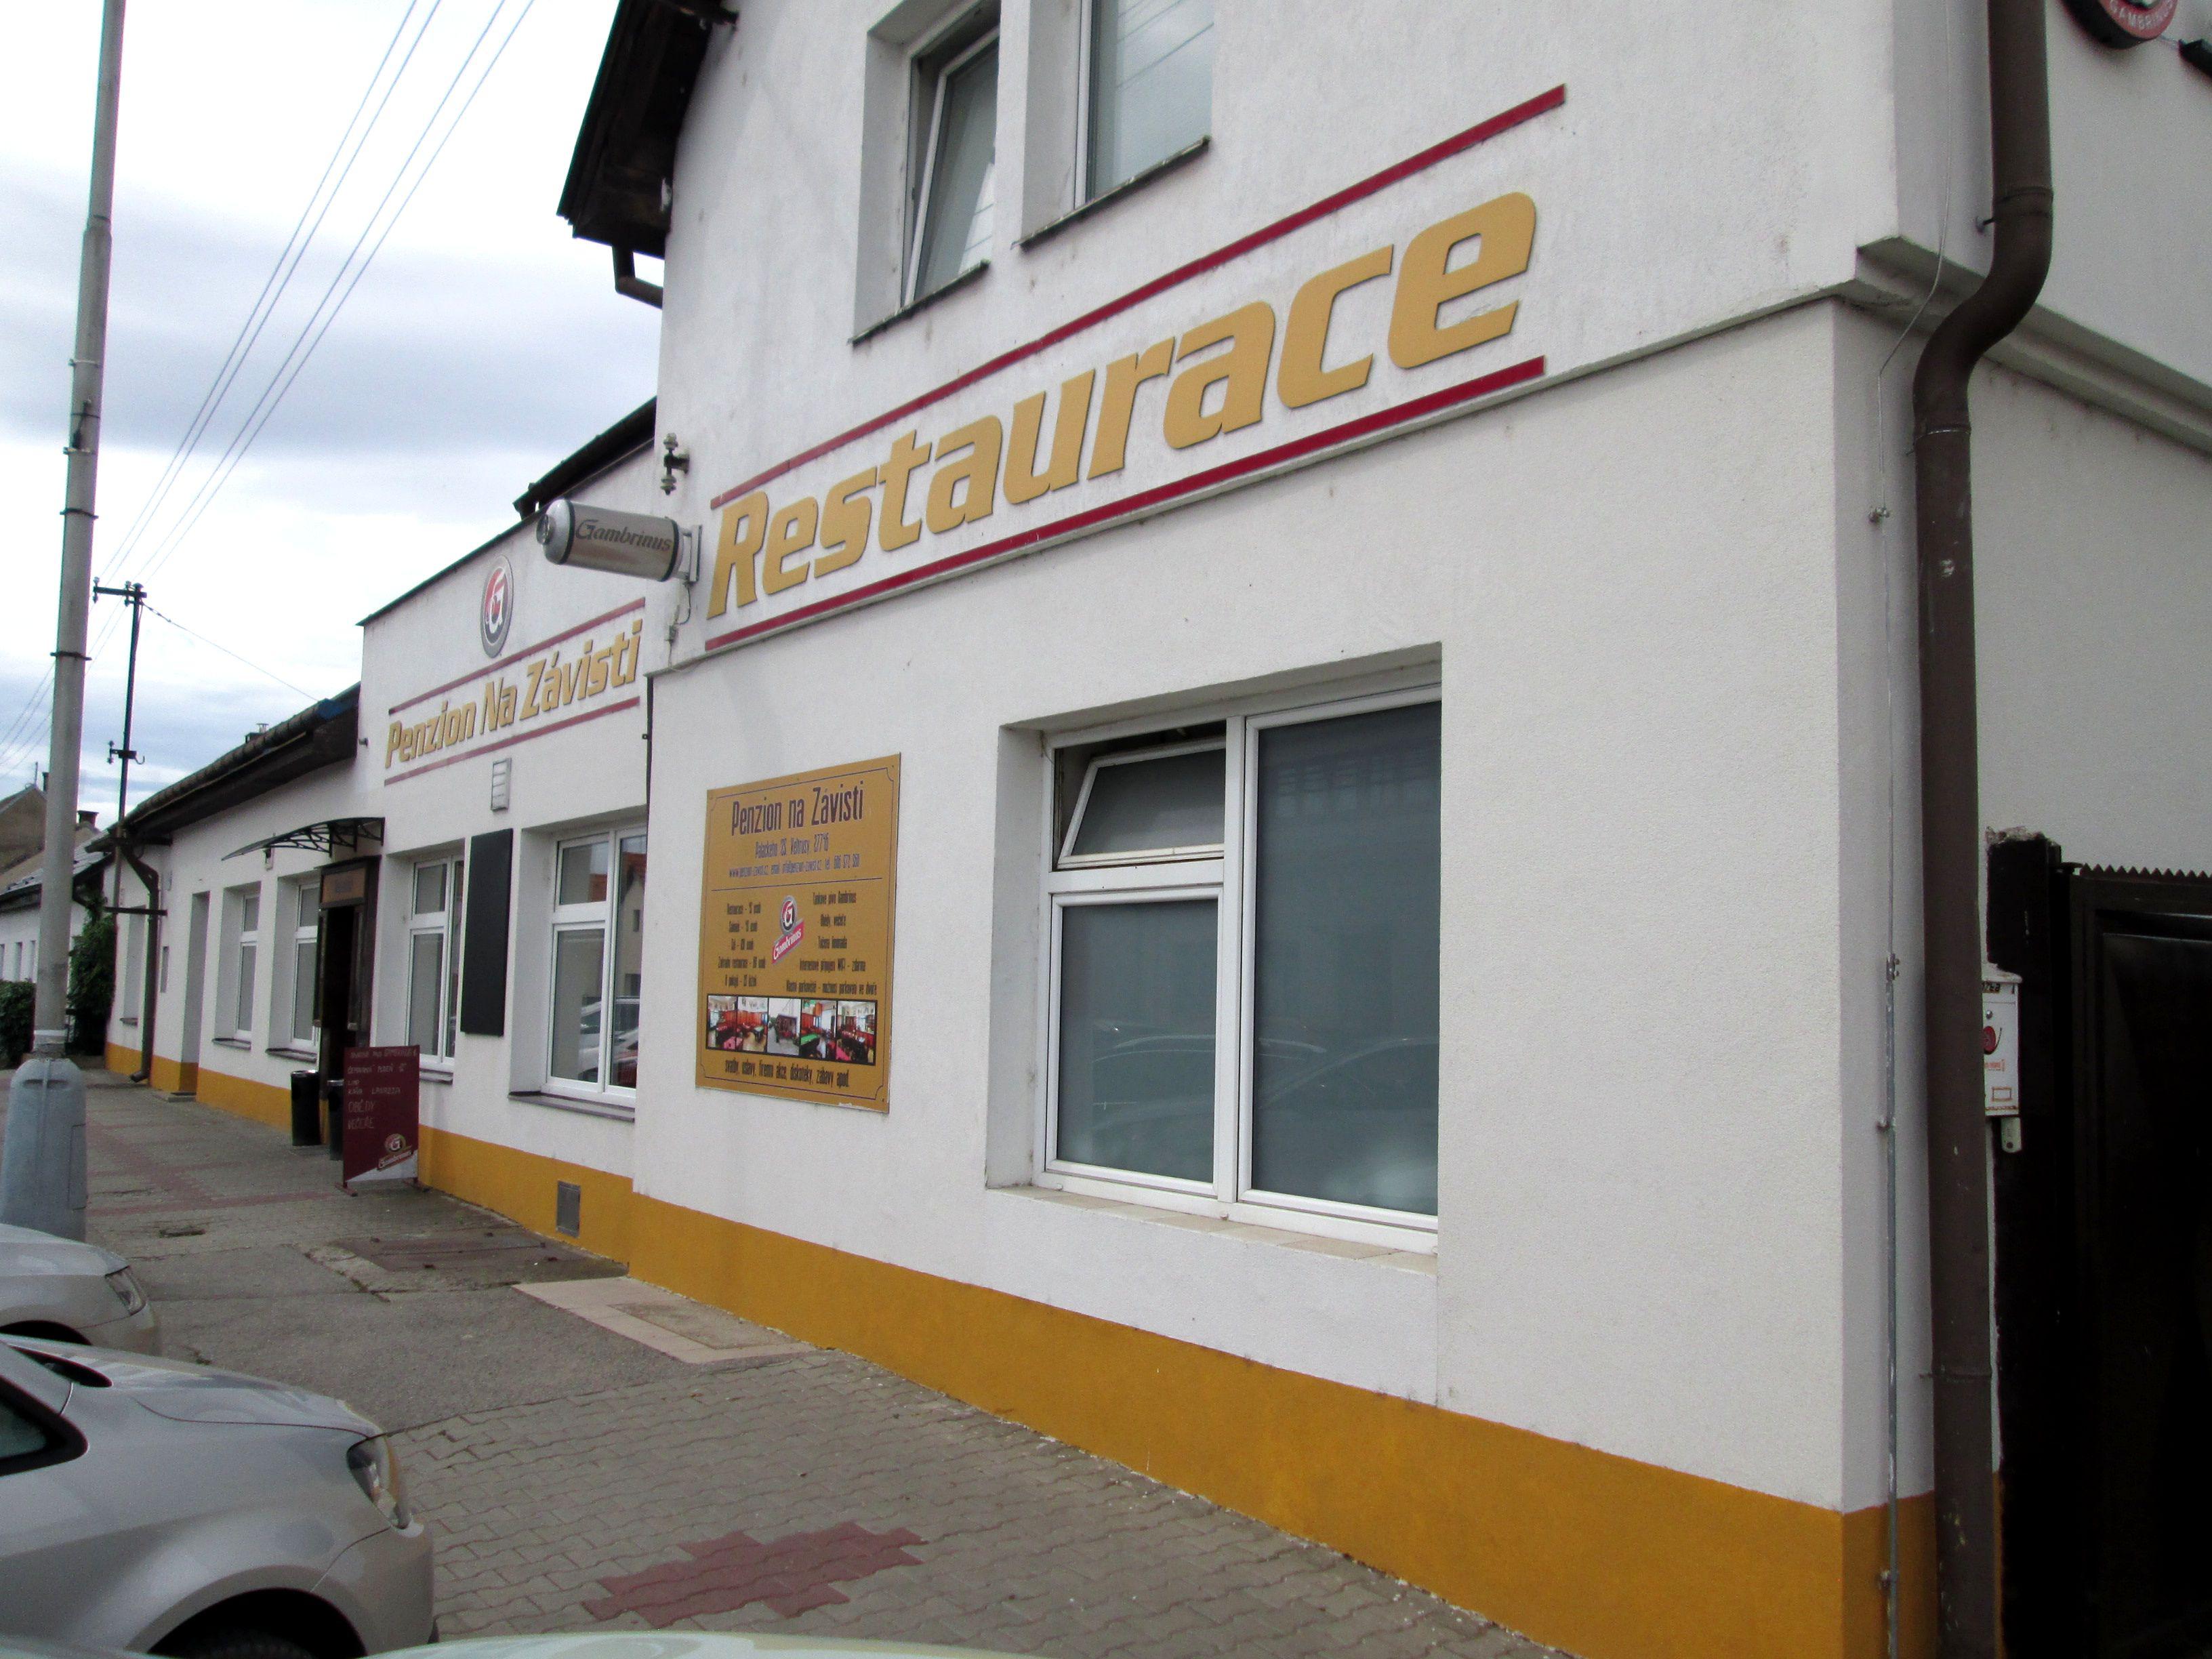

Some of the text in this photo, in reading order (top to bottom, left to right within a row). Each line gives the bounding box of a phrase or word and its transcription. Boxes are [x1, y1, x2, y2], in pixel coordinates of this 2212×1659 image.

[706, 191, 1538, 620] Restaurace
[575, 519, 672, 552] Gambrinus
[385, 619, 643, 769] Penzion Na Závisti
[731, 780, 863, 836] Penzion na Závisti
[774, 928, 802, 960] Gambrinus
